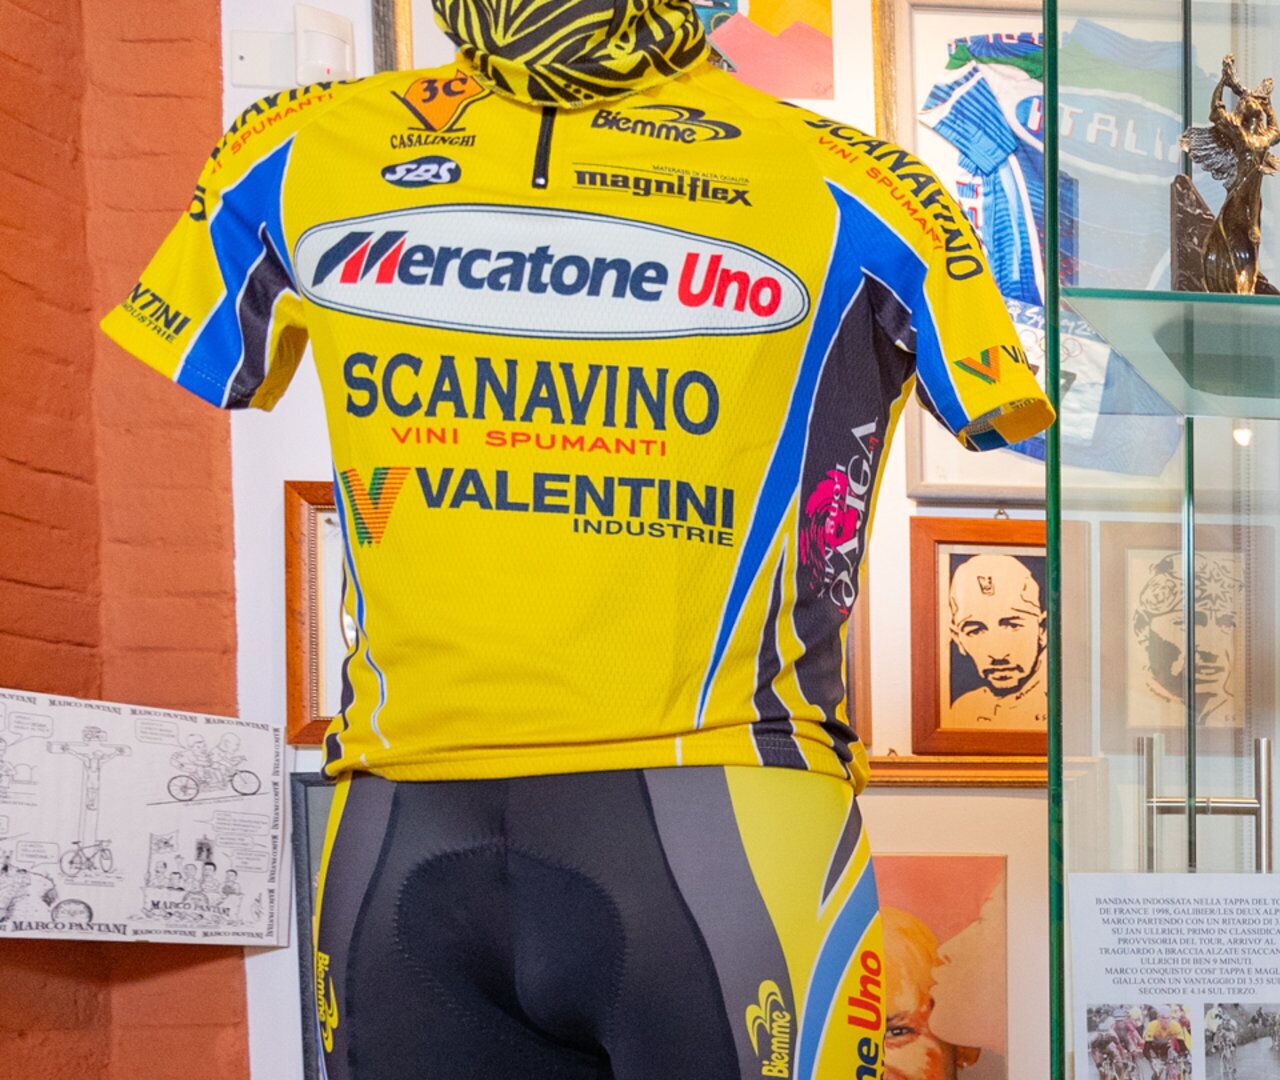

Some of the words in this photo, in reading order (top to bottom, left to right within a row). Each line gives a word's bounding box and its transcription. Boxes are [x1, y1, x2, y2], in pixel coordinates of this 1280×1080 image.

[591, 108, 697, 144] Biemme
[390, 133, 476, 150] CASALINGHI
[817, 135, 859, 164] VINI
[385, 161, 457, 184] SBS
[574, 169, 754, 208] magniflex
[311, 229, 668, 302] Mercatone
[676, 252, 783, 318] Uno
[343, 351, 721, 436] SCANAVINO
[391, 427, 459, 445] VINI
[485, 430, 667, 457] SPUMANTI
[415, 466, 735, 529] VALENTINI
[573, 517, 735, 548] INDUSTRIE
[49, 698, 80, 710] MARCO
[82, 701, 122, 715] PANTANI
[130, 708, 161, 719] MARCO
[162, 710, 198, 724] PANTANI
[204, 716, 235, 727] MARCO
[235, 719, 270, 732] PANTANI
[151, 900, 191, 912] MARCO
[1096, 897, 1141, 906] BANDANA
[1142, 897, 1192, 906] INDOSSATA
[1193, 897, 1221, 906] NELLA
[1223, 897, 1250, 906] TAPPA
[1252, 897, 1269, 906] DEL
[1100, 907, 1111, 916] DE
[1113, 907, 1149, 916] FRANCE
[1236, 907, 1261, 916] DEUX
[12, 919, 66, 933] MARCO
[68, 921, 128, 936] PANTANI
[1102, 917, 1135, 926] MARCO
[1137, 917, 1184, 926] PARTENDO
[1185, 917, 1204, 926] CON
[1206, 917, 1219, 926] UN
[1221, 917, 1261, 926] RITARDO
[1262, 917, 1273, 926] DI
[131, 928, 162, 937] MARCO
[162, 929, 198, 938] PANTANI
[201, 928, 232, 938] MARCO
[232, 930, 264, 940] PANTANI
[1112, 927, 1123, 936] SU
[1125, 927, 1141, 936] JAN
[1187, 927, 1216, 936] PRIMO
[1218, 927, 1227, 936] IN
[1118, 937, 1178, 946] PROVVISORIA
[1180, 937, 1197, 946] DEL
[1264, 937, 1276, 946] AL
[1099, 947, 1155, 956] TRAGUARDO
[1157, 947, 1163, 956] A
[1165, 947, 1204, 956] BRACCIA
[1206, 947, 1239, 956] ALZATE
[1140, 957, 1180, 966] ULLRICH
[1181, 957, 1191, 966] DI
[1193, 957, 1211, 966] BEN
[1212, 957, 1218, 966] 9
[1105, 967, 1138, 977] MARCO
[1219, 967, 1245, 977] TAPPA
[1247, 967, 1252, 977] E
[1112, 977, 1146, 986] GIALLA
[1147, 977, 1167, 986] CON
[1168, 977, 1181, 986] UN
[1183, 977, 1235, 986] VANTAGGIO
[1237, 977, 1247, 986] DI
[848, 950, 883, 1031] Uno
[1138, 987, 1181, 996] SECONDO
[1183, 987, 1188, 996] E
[1208, 987, 1225, 996] SUL
[762, 1010, 791, 1080] Biemme
